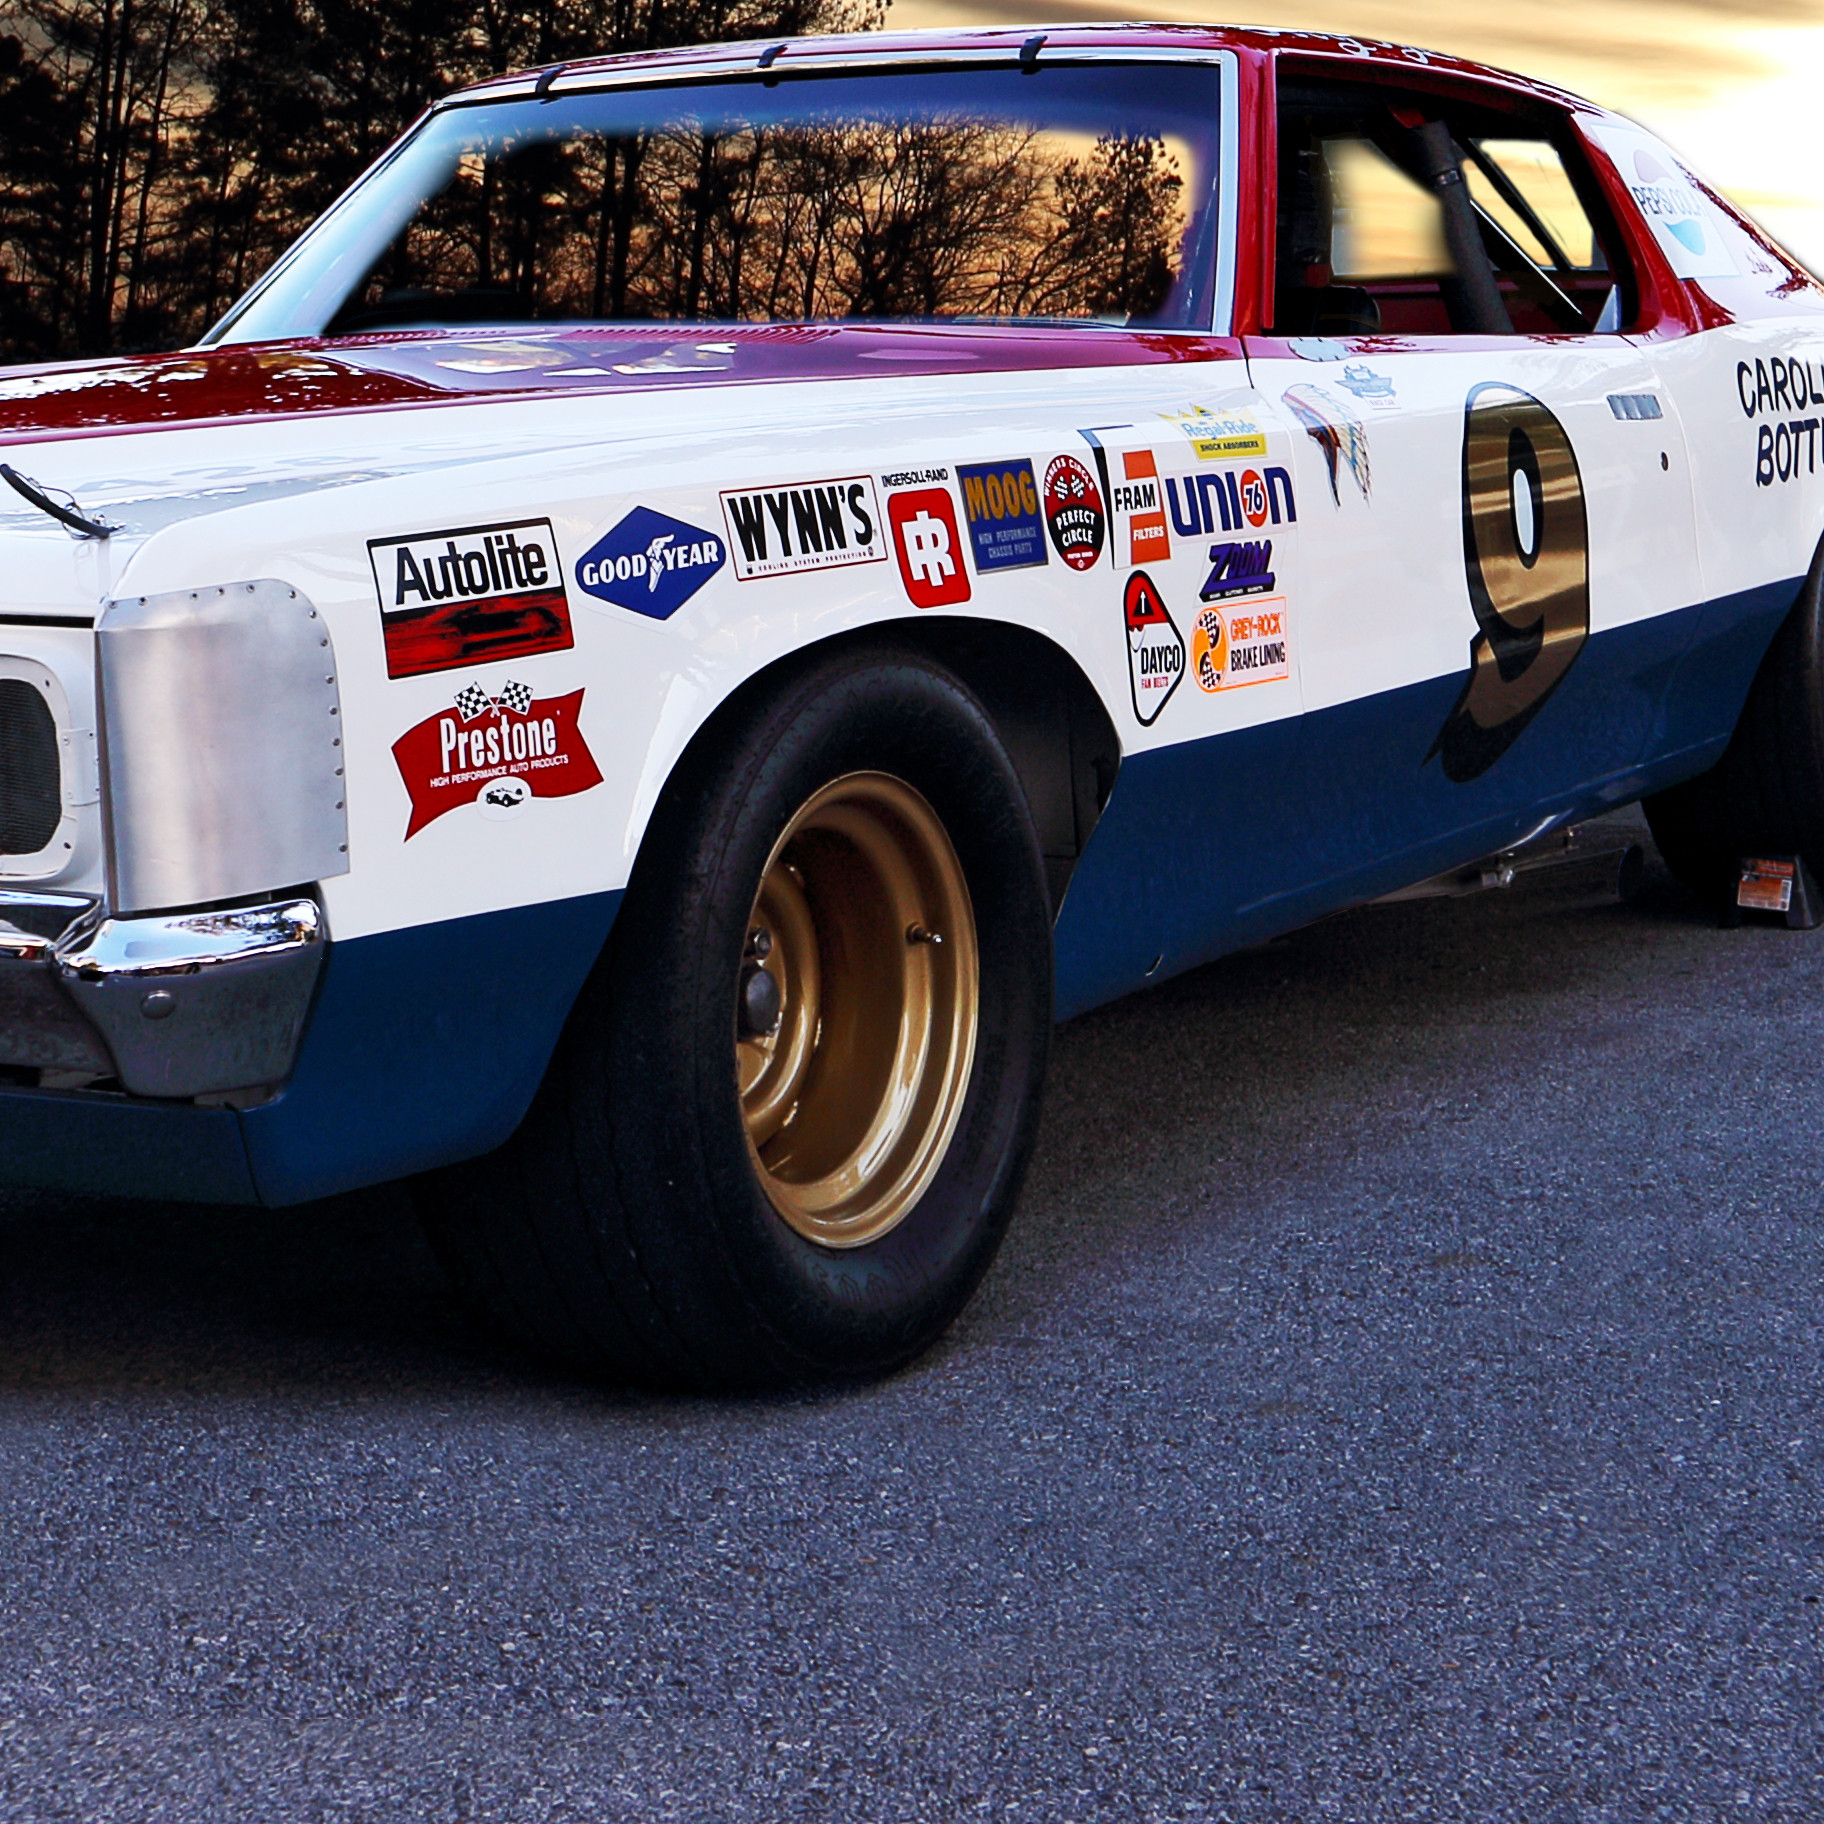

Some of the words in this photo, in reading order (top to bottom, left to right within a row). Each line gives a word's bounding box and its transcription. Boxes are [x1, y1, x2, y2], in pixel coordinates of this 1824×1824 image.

[964, 470, 1036, 522] MOOG
[1114, 484, 1156, 512] FRAM
[1244, 480, 1265, 515] 76
[727, 484, 874, 563] WYNN'S
[1056, 509, 1096, 530] PERFECT
[1133, 525, 1164, 541] FILTERS
[1062, 528, 1093, 547] CIRCLE
[395, 533, 548, 605] Autolite
[1199, 539, 1275, 600] ZOOM
[1421, 381, 1590, 782] 9
[1141, 645, 1180, 674] DAYCO
[1231, 646, 1258, 672] BRAKE
[1260, 641, 1285, 667] LINING
[439, 715, 557, 773] Prestone
[430, 775, 449, 788] HIGH
[452, 766, 507, 784] PERFORMANCE
[510, 762, 529, 774] AUTO
[531, 755, 569, 770] PRODUCTS
